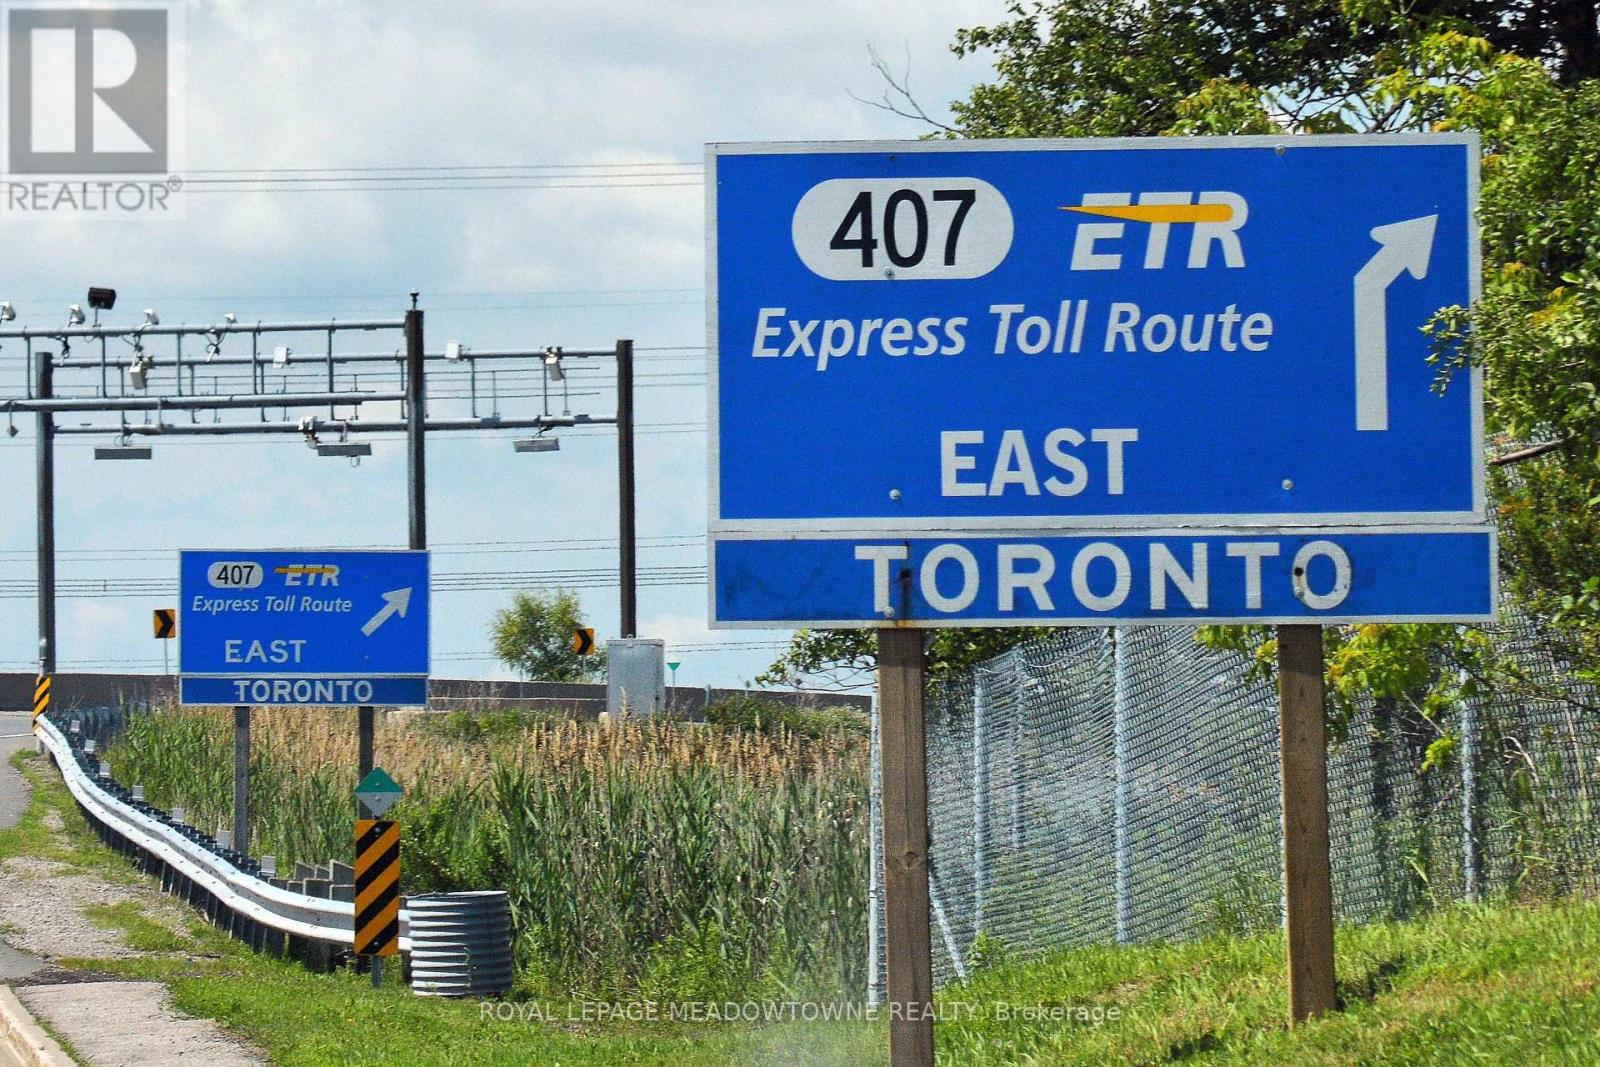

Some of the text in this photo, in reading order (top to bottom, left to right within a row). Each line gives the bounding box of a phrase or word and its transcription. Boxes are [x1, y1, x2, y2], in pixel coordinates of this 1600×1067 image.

[829, 189, 1249, 271] 407 ETR
[752, 300, 1274, 371] Express Toll Route
[939, 427, 1139, 497] EAST
[216, 564, 340, 586] 407 ETR
[854, 540, 1353, 615] TORONTO
[192, 595, 352, 615] Express Toll Route
[225, 639, 307, 663] EAST
[234, 680, 373, 702] TORONTO
